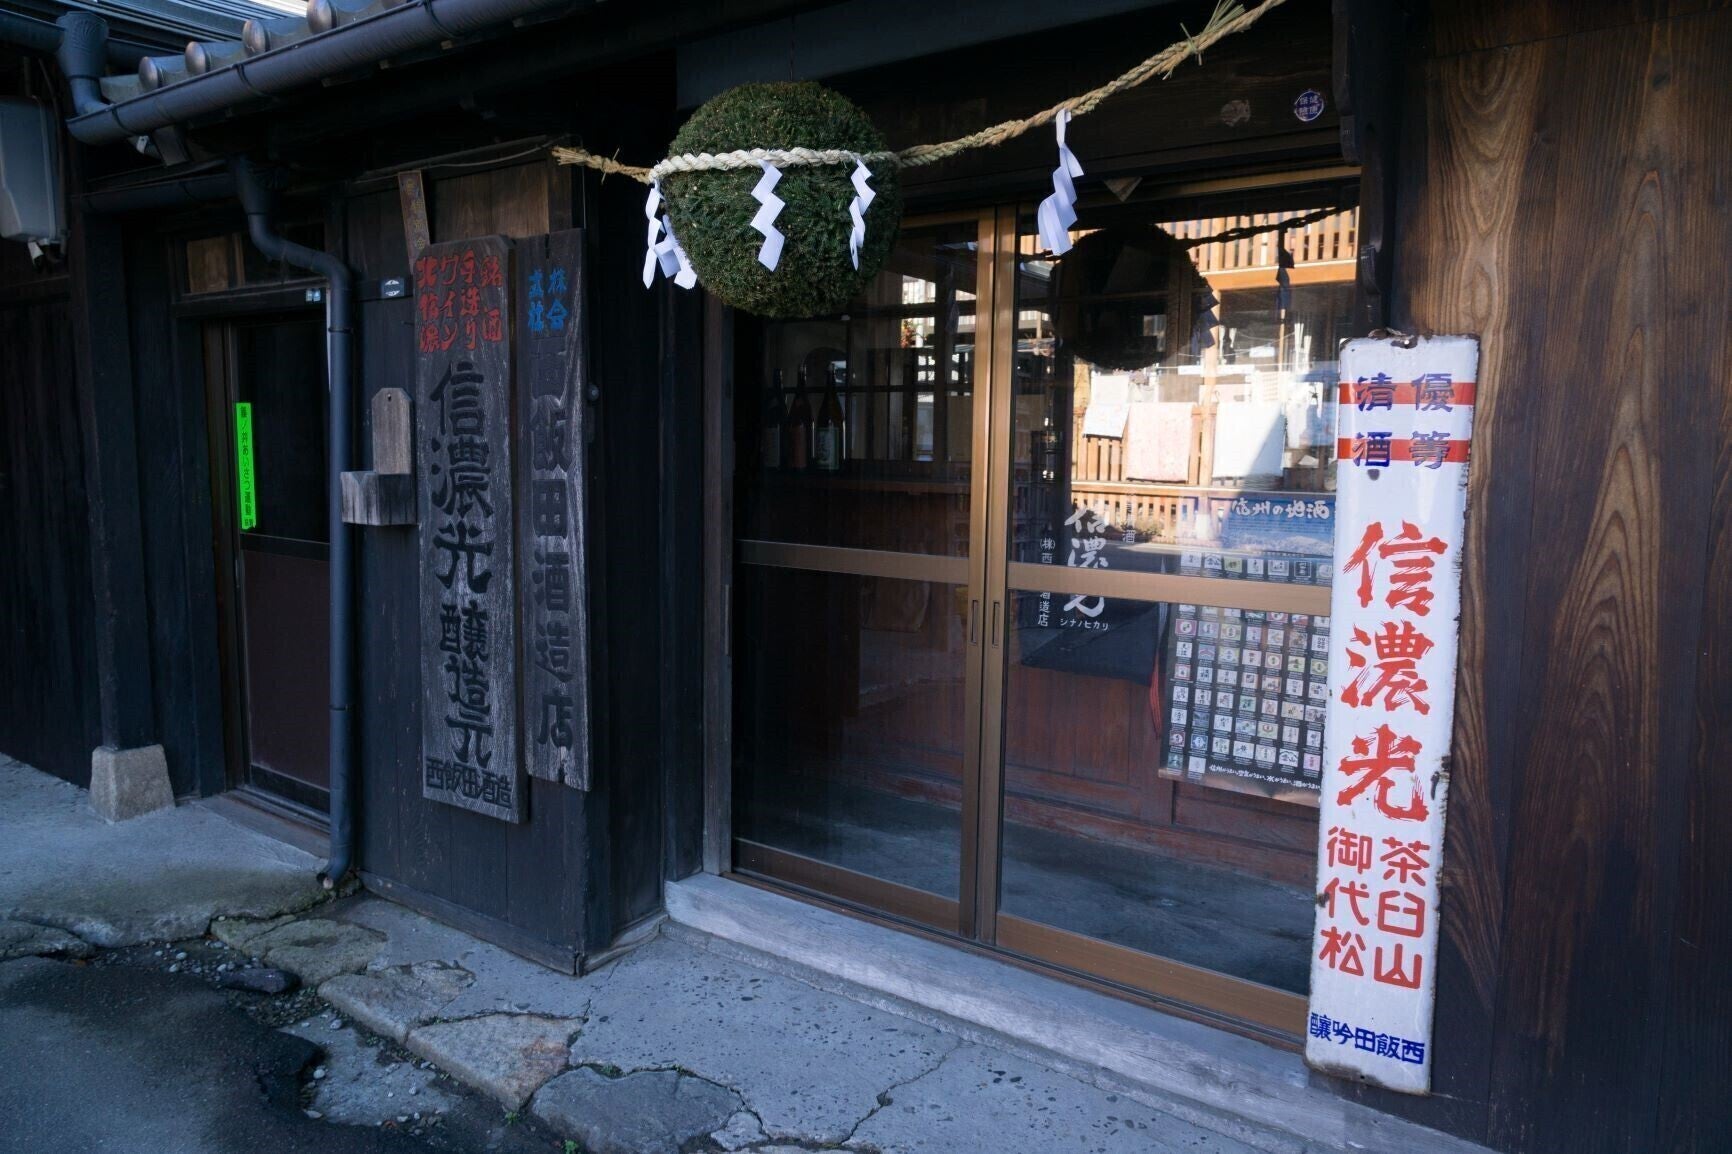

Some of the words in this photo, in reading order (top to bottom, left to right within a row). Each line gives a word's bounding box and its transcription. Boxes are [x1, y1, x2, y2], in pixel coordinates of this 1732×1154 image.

[439, 253, 461, 352] ワイン
[460, 248, 481, 350] 手造り
[1352, 371, 1397, 468] 清酒
[1408, 372, 1455, 470] 優等
[1231, 497, 1330, 519] 信州の地酒
[1059, 618, 1109, 632] シナノヒカリ
[1340, 520, 1448, 822] 信濃光
[1318, 826, 1373, 978] 御代松
[1372, 837, 1431, 991] 茶臼山
